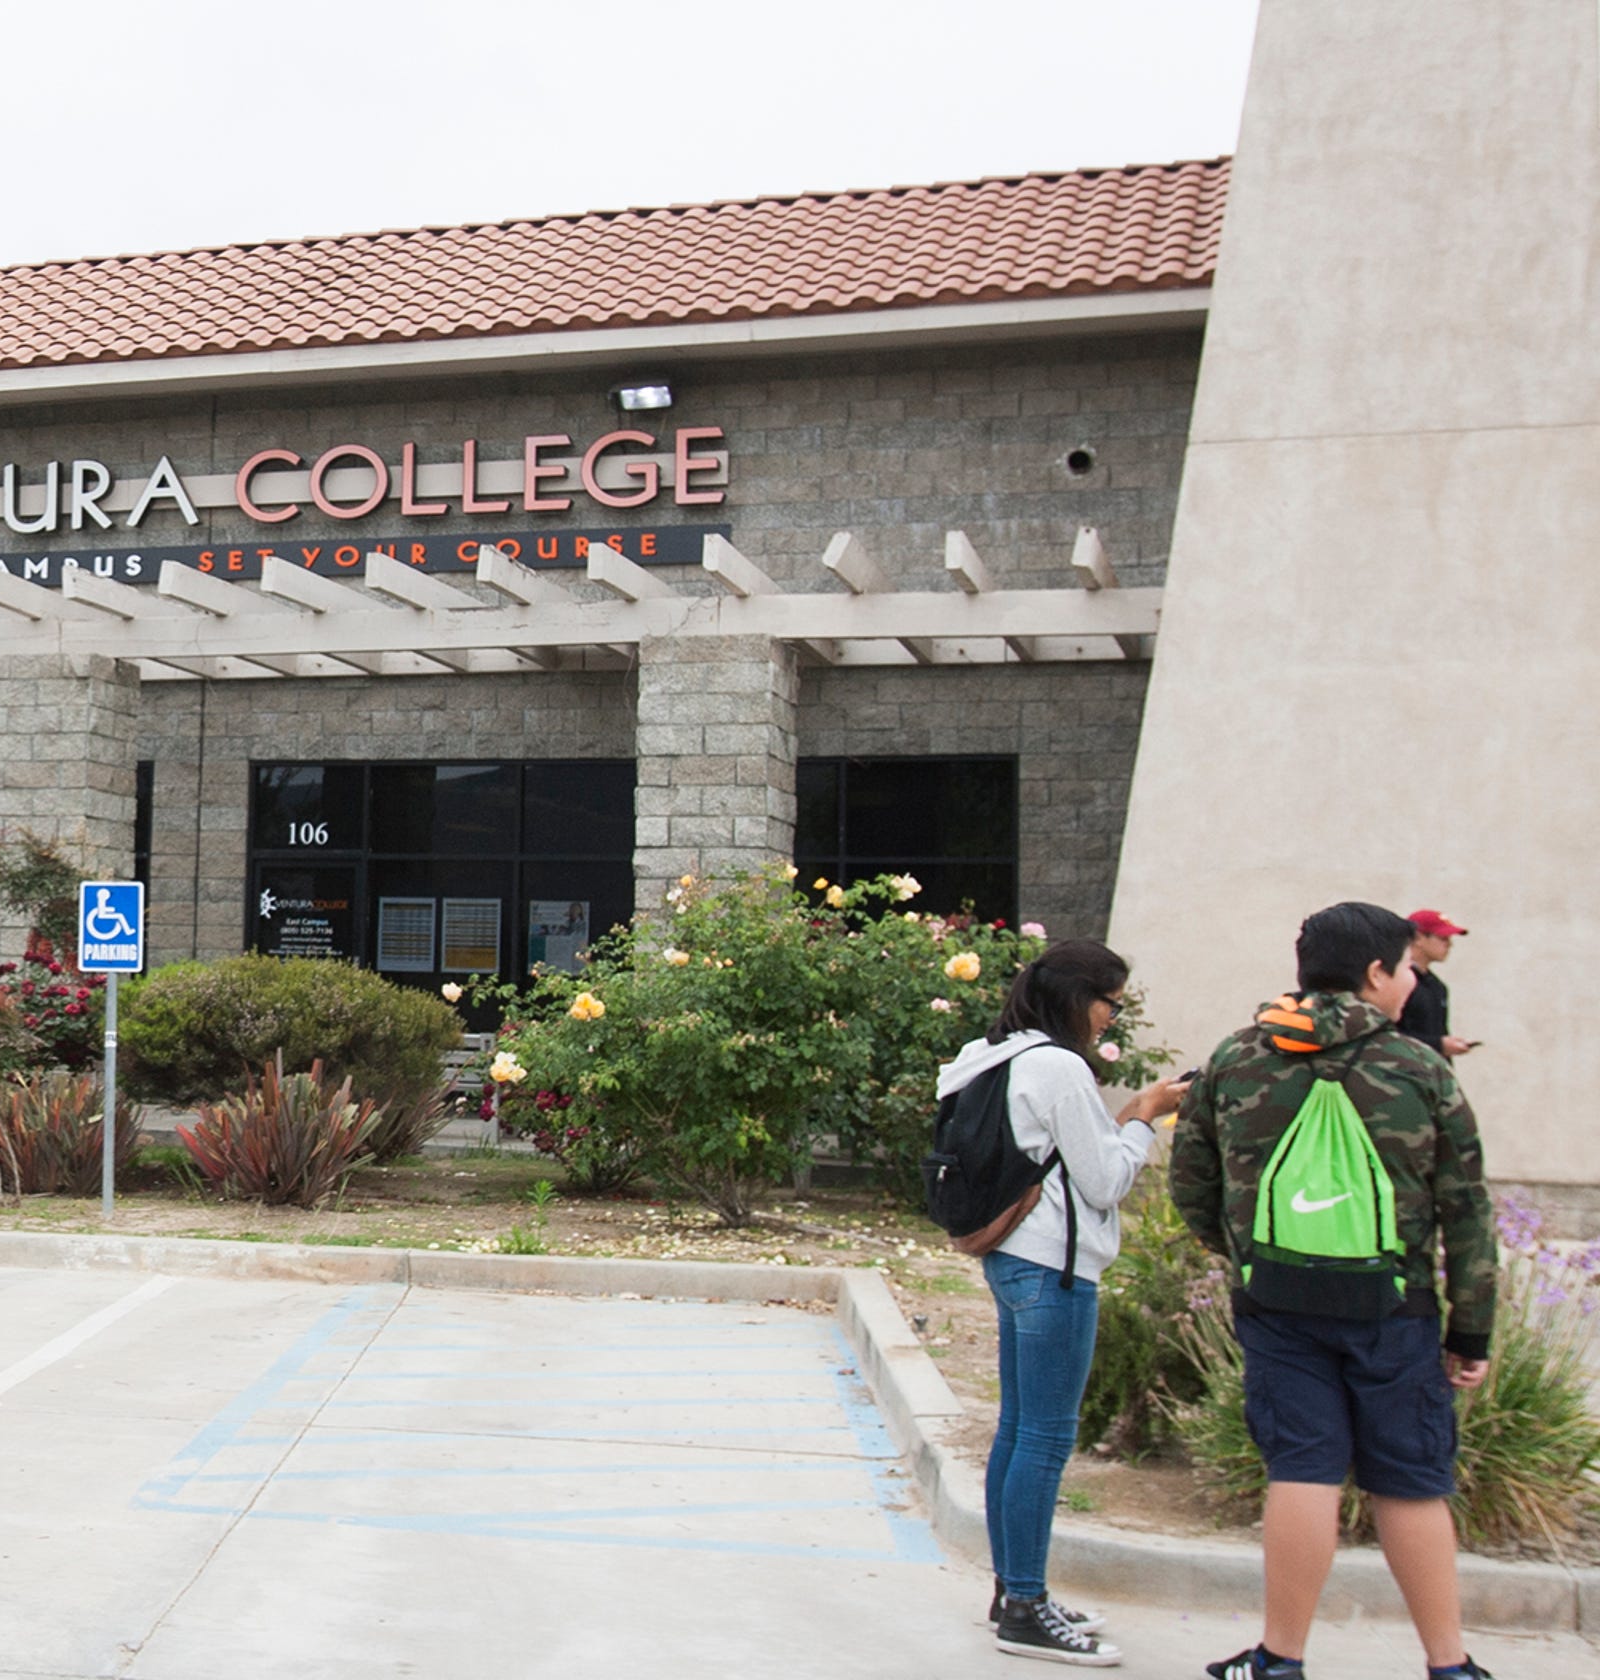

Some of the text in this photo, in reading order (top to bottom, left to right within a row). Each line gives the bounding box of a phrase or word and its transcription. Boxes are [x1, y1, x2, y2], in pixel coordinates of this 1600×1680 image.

[234, 426, 725, 524] COLLEGE
[197, 549, 276, 573] SET
[456, 533, 659, 563] COURSE
[288, 821, 330, 845] 106
[84, 943, 137, 961] PARKING
